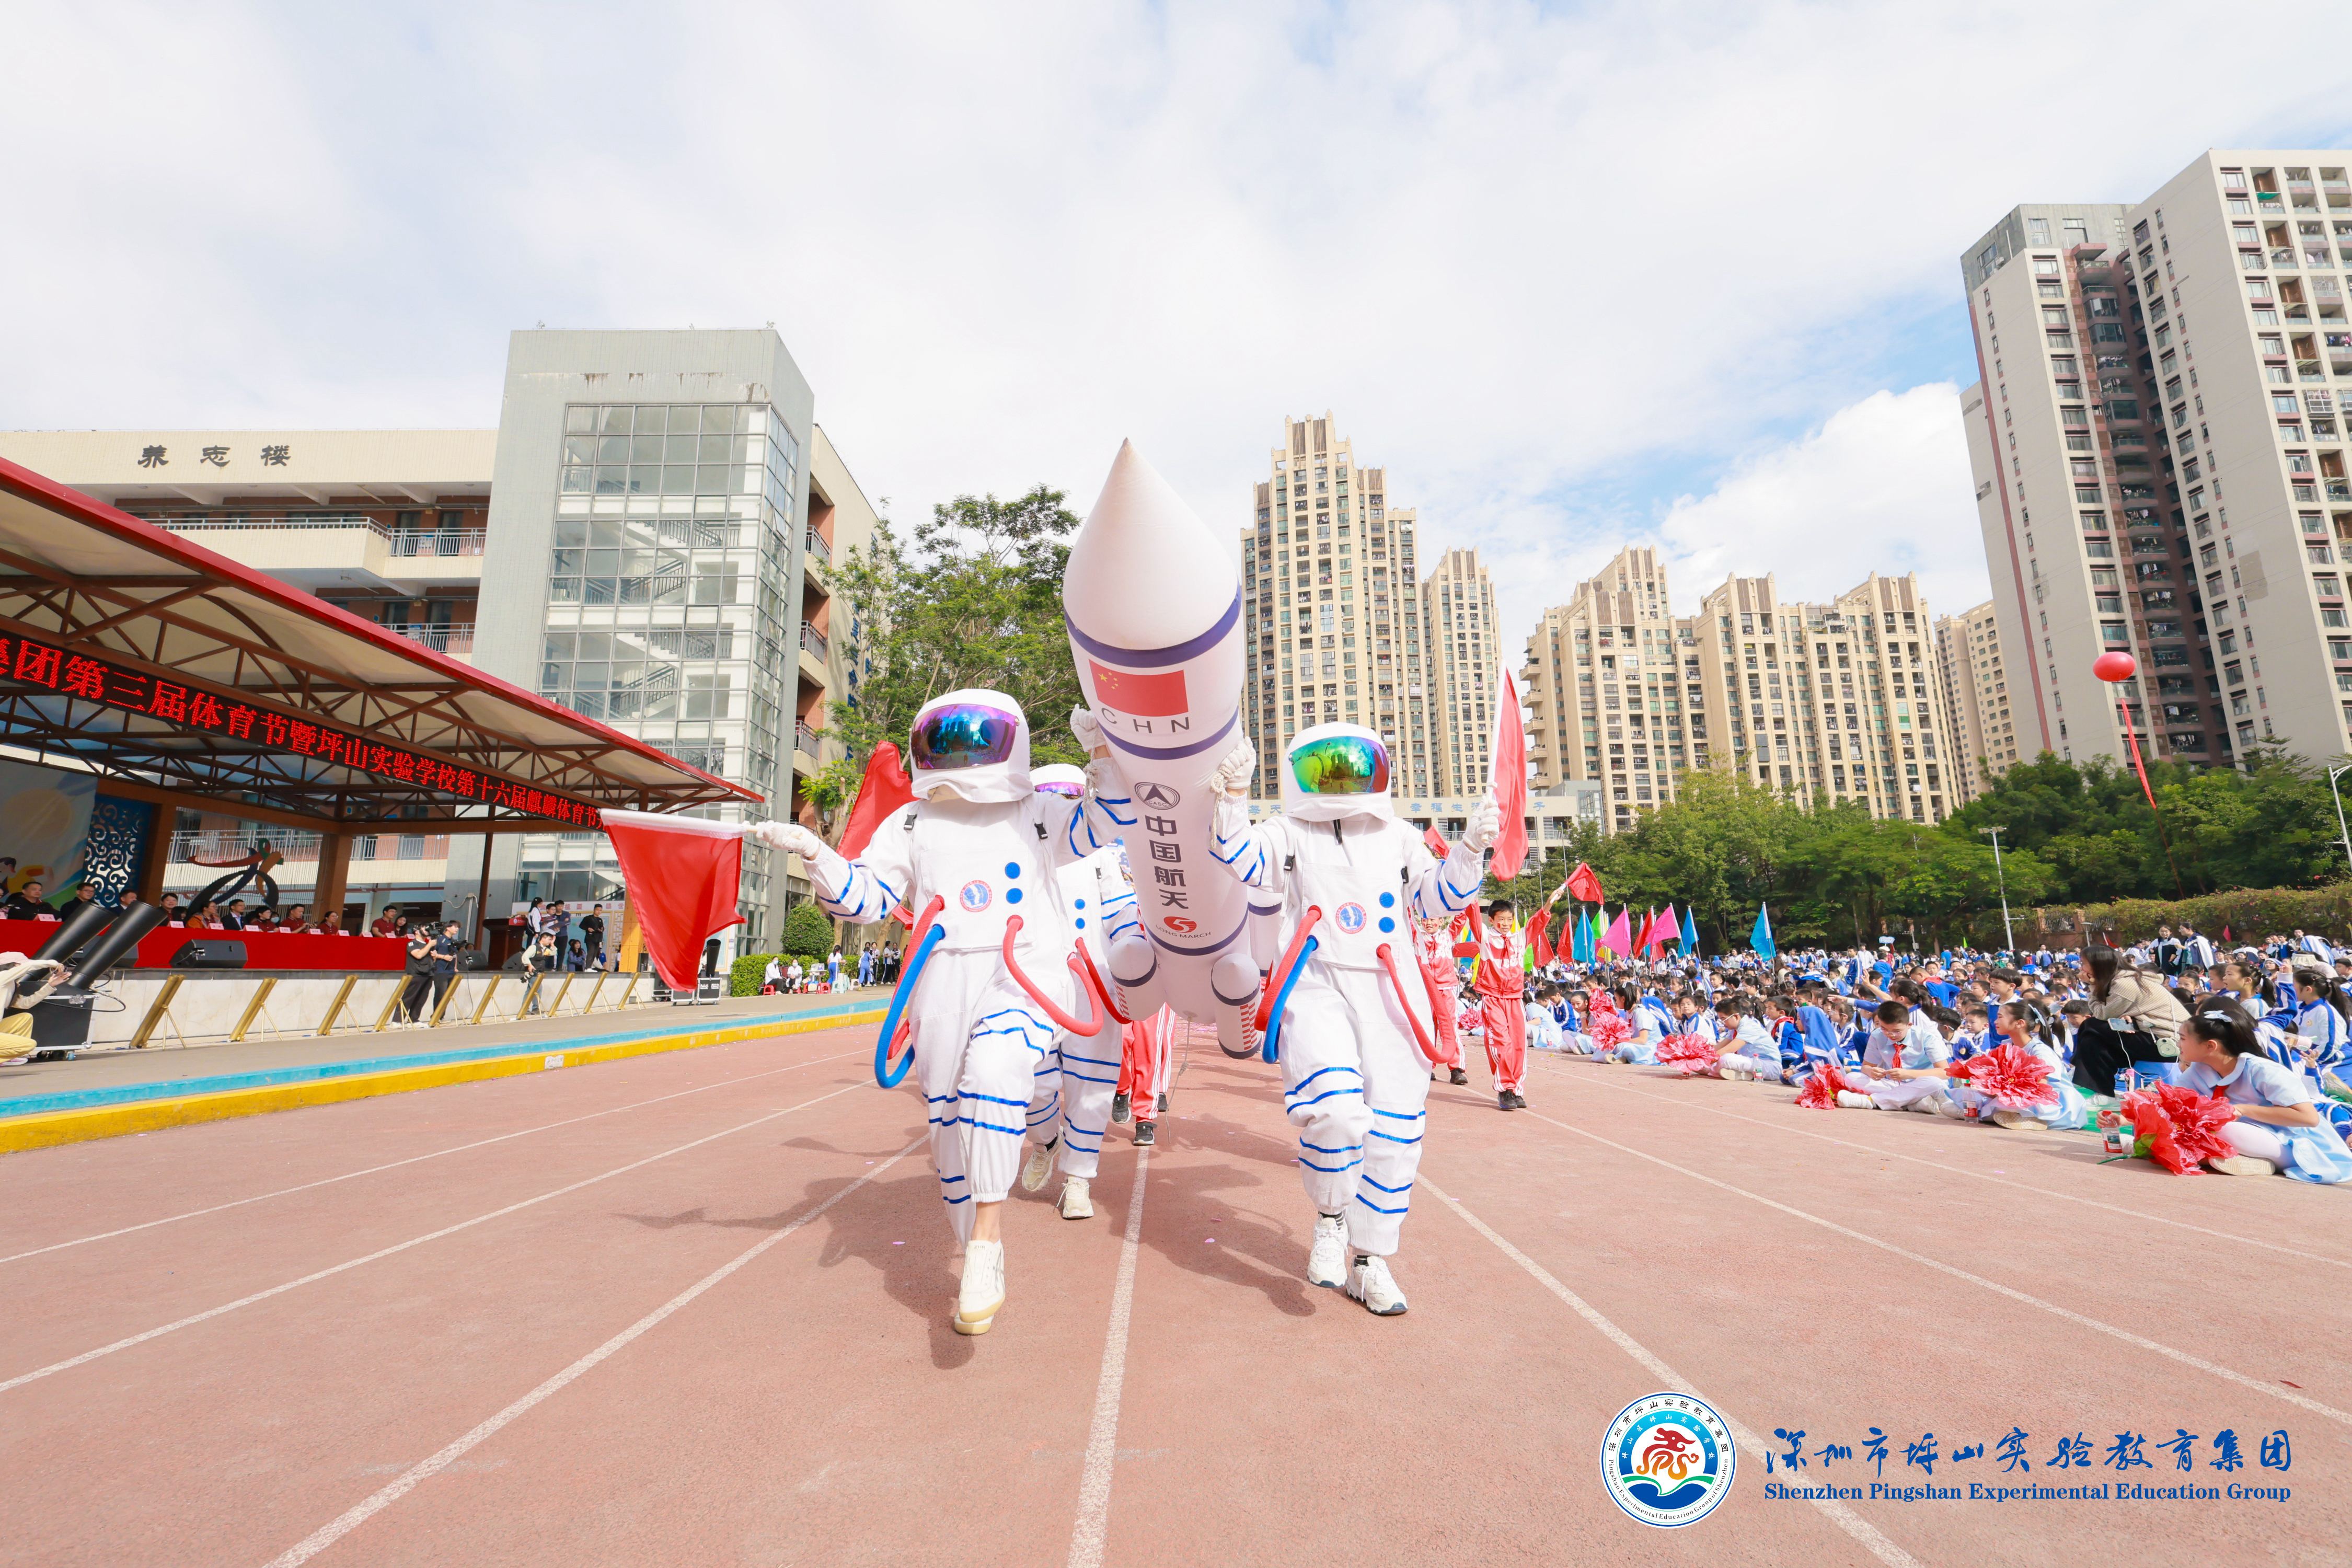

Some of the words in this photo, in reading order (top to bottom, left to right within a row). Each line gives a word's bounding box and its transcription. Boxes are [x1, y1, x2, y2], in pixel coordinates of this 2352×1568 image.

[137, 445, 292, 468] 养志楼
[1101, 707, 1190, 734] CHN
[1145, 815, 1189, 909] 中国航天
[1156, 924, 1178, 937] LONG
